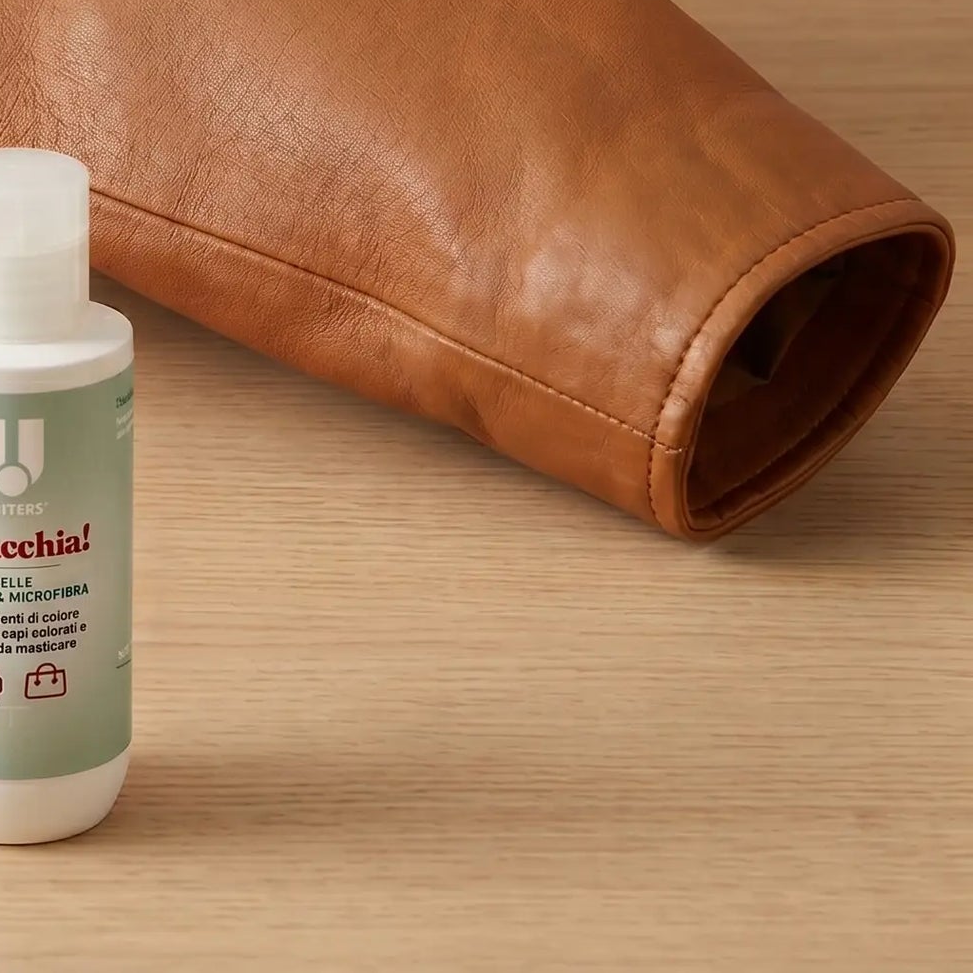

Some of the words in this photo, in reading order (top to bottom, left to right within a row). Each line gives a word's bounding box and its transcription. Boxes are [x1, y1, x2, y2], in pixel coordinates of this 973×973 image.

[9, 583, 89, 603] MICROFIBRA
[28, 612, 39, 624] di
[1, 627, 29, 642] capi
[80, 622, 87, 632] e
[15, 639, 77, 654] masticare
